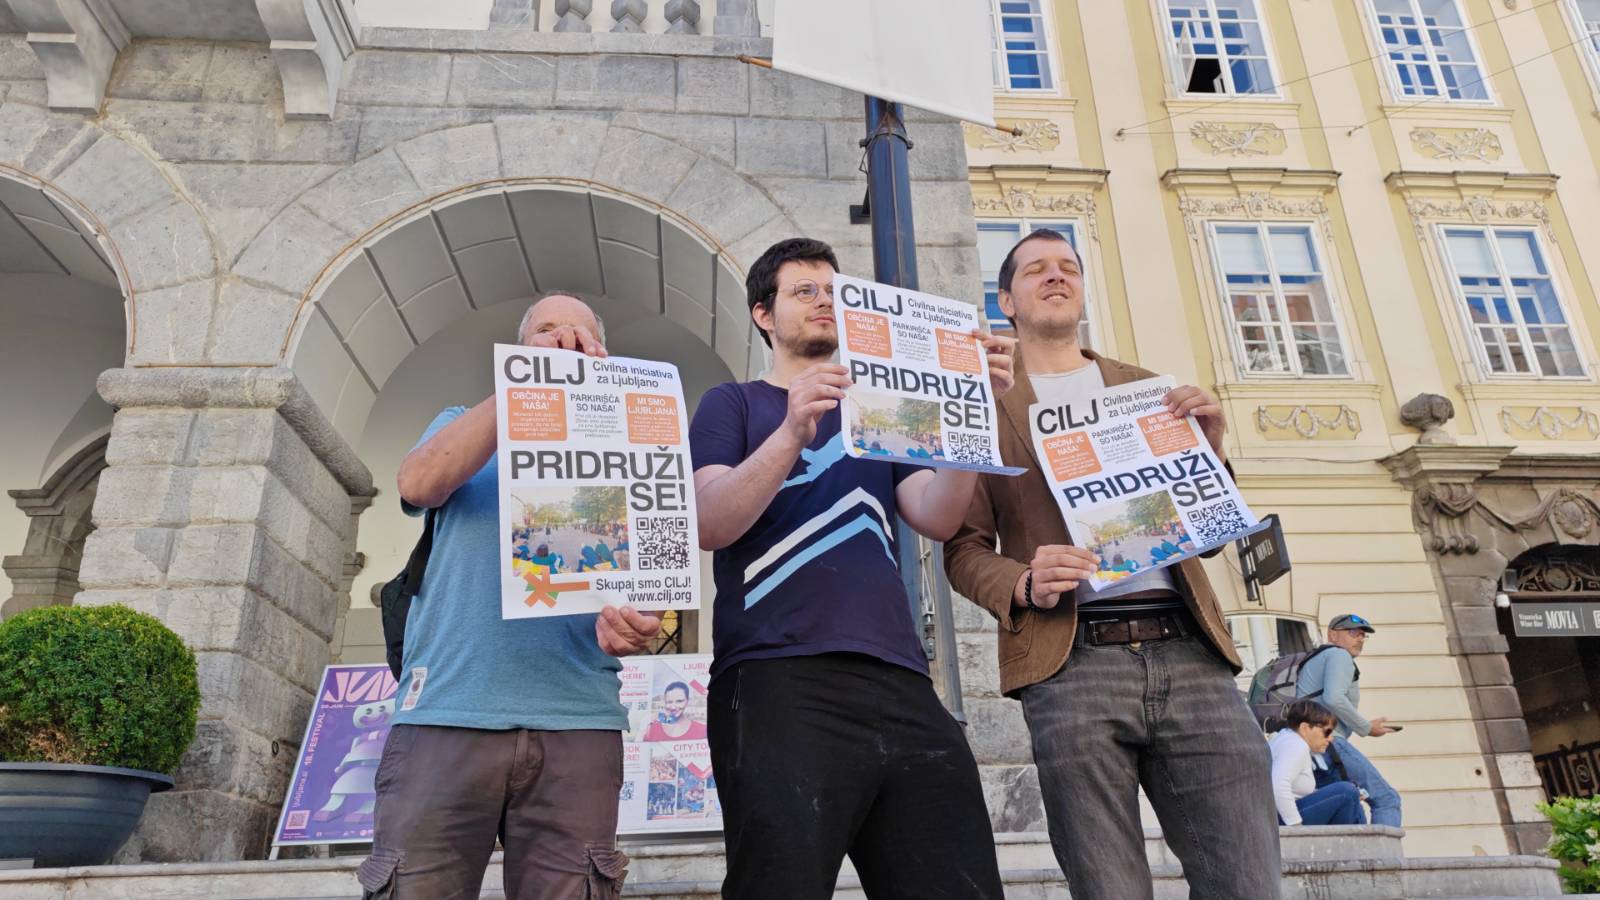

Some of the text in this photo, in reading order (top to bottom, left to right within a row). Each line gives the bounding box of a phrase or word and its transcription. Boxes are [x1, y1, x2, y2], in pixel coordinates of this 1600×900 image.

[840, 283, 903, 316] CILJ
[907, 298, 973, 320] Civilna iniciativa
[911, 310, 961, 327] za Ljubljano
[503, 354, 586, 385] CILJ
[592, 361, 674, 380] Civilna iniciativa
[596, 375, 659, 389] za Ljubljano
[850, 359, 988, 403] PRIDRUŽI
[512, 390, 559, 401] OBČINA JE
[522, 400, 550, 410] NAŠA!
[570, 394, 620, 404] PARKIRIŠČA
[637, 397, 666, 407] MI SMO
[1102, 384, 1172, 407] Civilna iniciativa
[576, 403, 616, 413] SO NAŠA!
[628, 405, 678, 416] LJUBLJANA!
[943, 401, 990, 431] SE!
[1036, 399, 1100, 434] CILJ
[1107, 399, 1162, 418] za Ljubljano
[510, 446, 685, 480] PRIDRUŽI
[1063, 450, 1216, 509] PRIDRUŽI
[630, 482, 687, 512] SE!
[1172, 473, 1230, 507] SE!
[595, 576, 692, 592] Skupaj smo CILJ!
[627, 590, 692, 604] www.cilj.org
[1545, 610, 1579, 629] MOVIA
[307, 712, 326, 753] FESTIVAL
[673, 742, 709, 752] CITY TO
